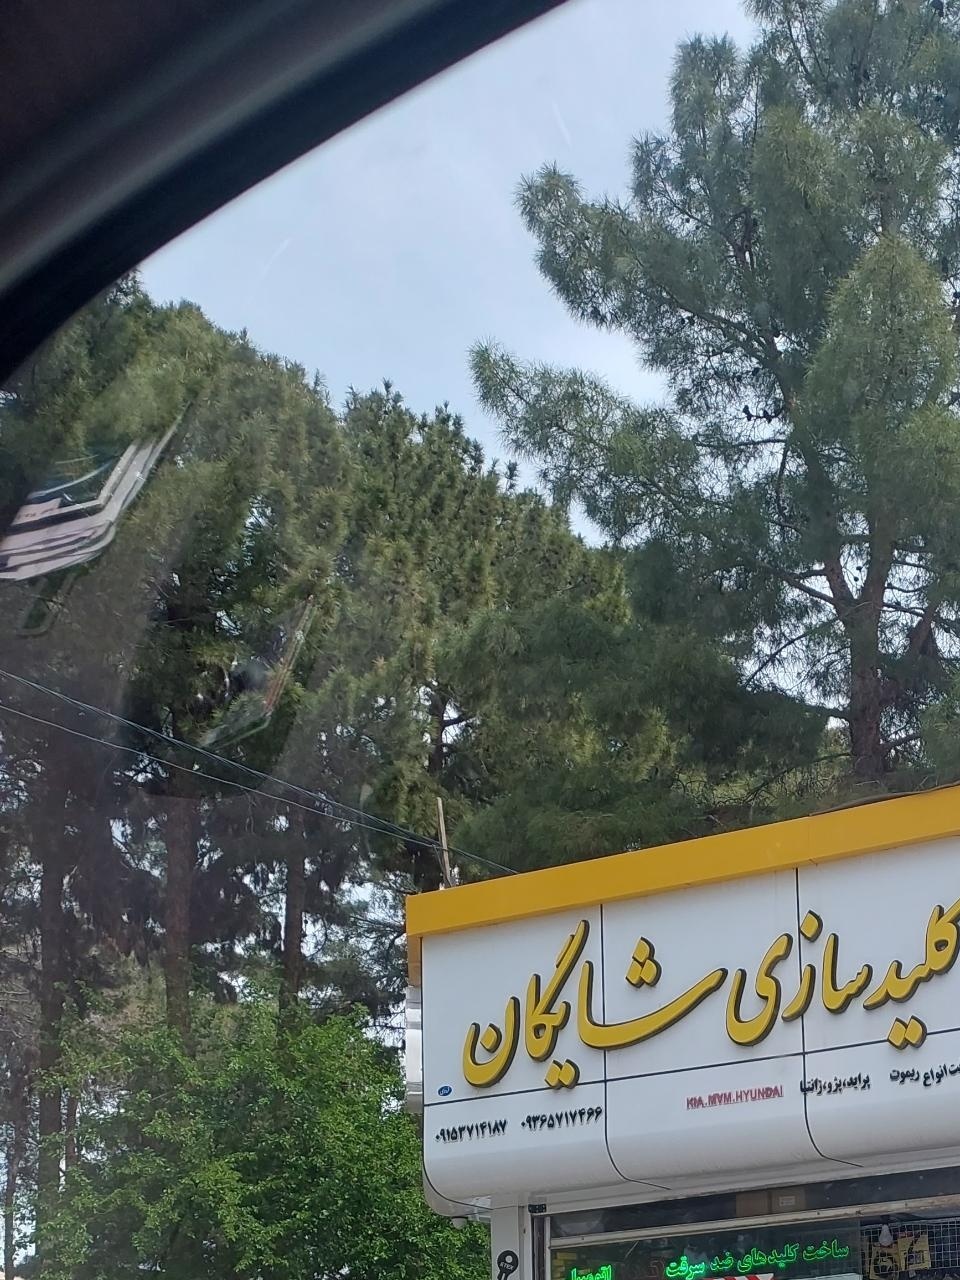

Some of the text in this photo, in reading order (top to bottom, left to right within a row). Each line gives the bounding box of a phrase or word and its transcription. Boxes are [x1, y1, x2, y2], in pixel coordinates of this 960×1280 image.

[463, 919, 729, 1089] شایگان
[889, 1067, 921, 1085] ریموت
[922, 1063, 948, 1087] انواع
[710, 1251, 734, 1271] ضد
[803, 1239, 849, 1261] ساخت
[665, 1255, 706, 1280] سرقت
